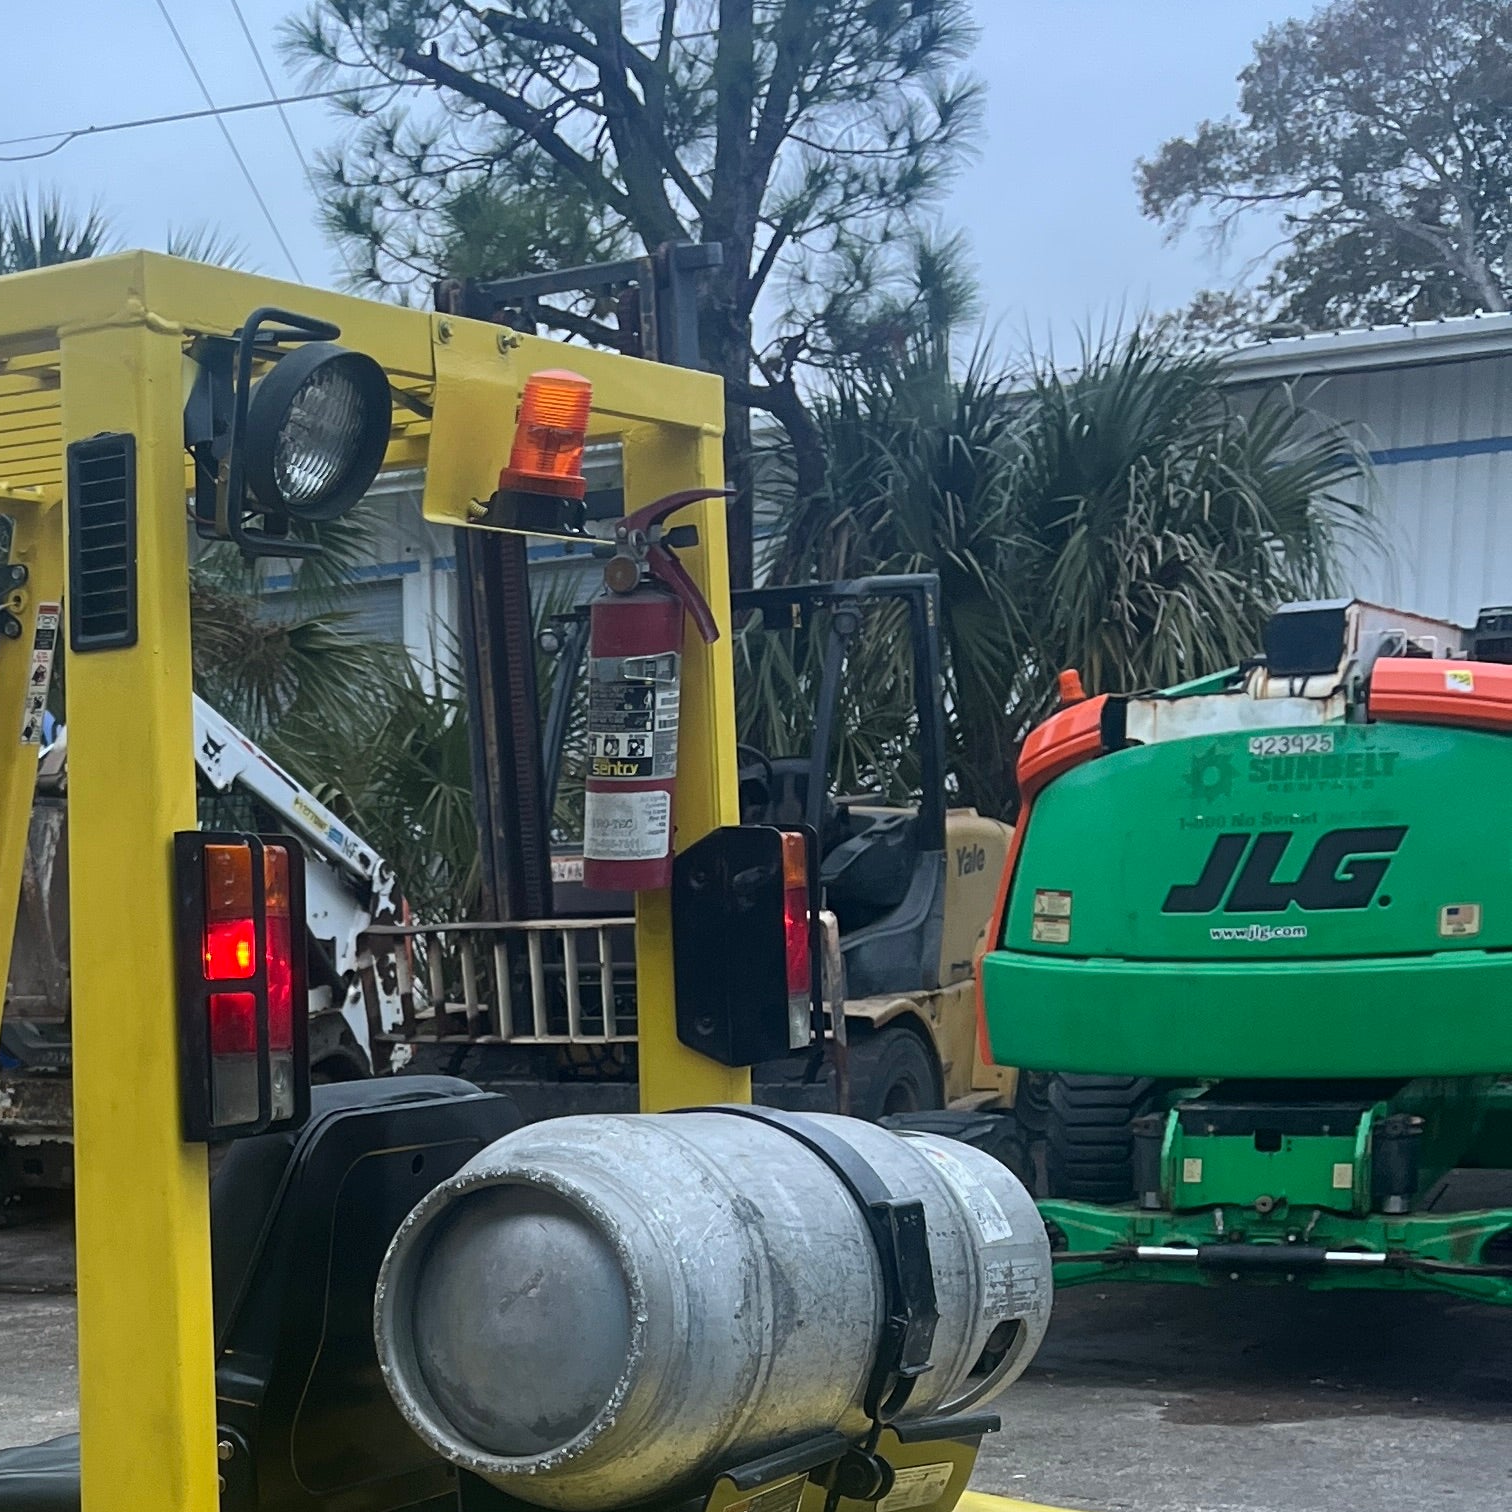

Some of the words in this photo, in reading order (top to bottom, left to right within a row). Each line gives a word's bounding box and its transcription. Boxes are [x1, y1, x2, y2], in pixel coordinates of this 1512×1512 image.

[1251, 734, 1333, 755] 923925
[593, 761, 639, 776] sentry
[1248, 752, 1400, 783] SUNBELT
[956, 844, 985, 878] Yale
[1210, 924, 1307, 941] www.jlg.com
